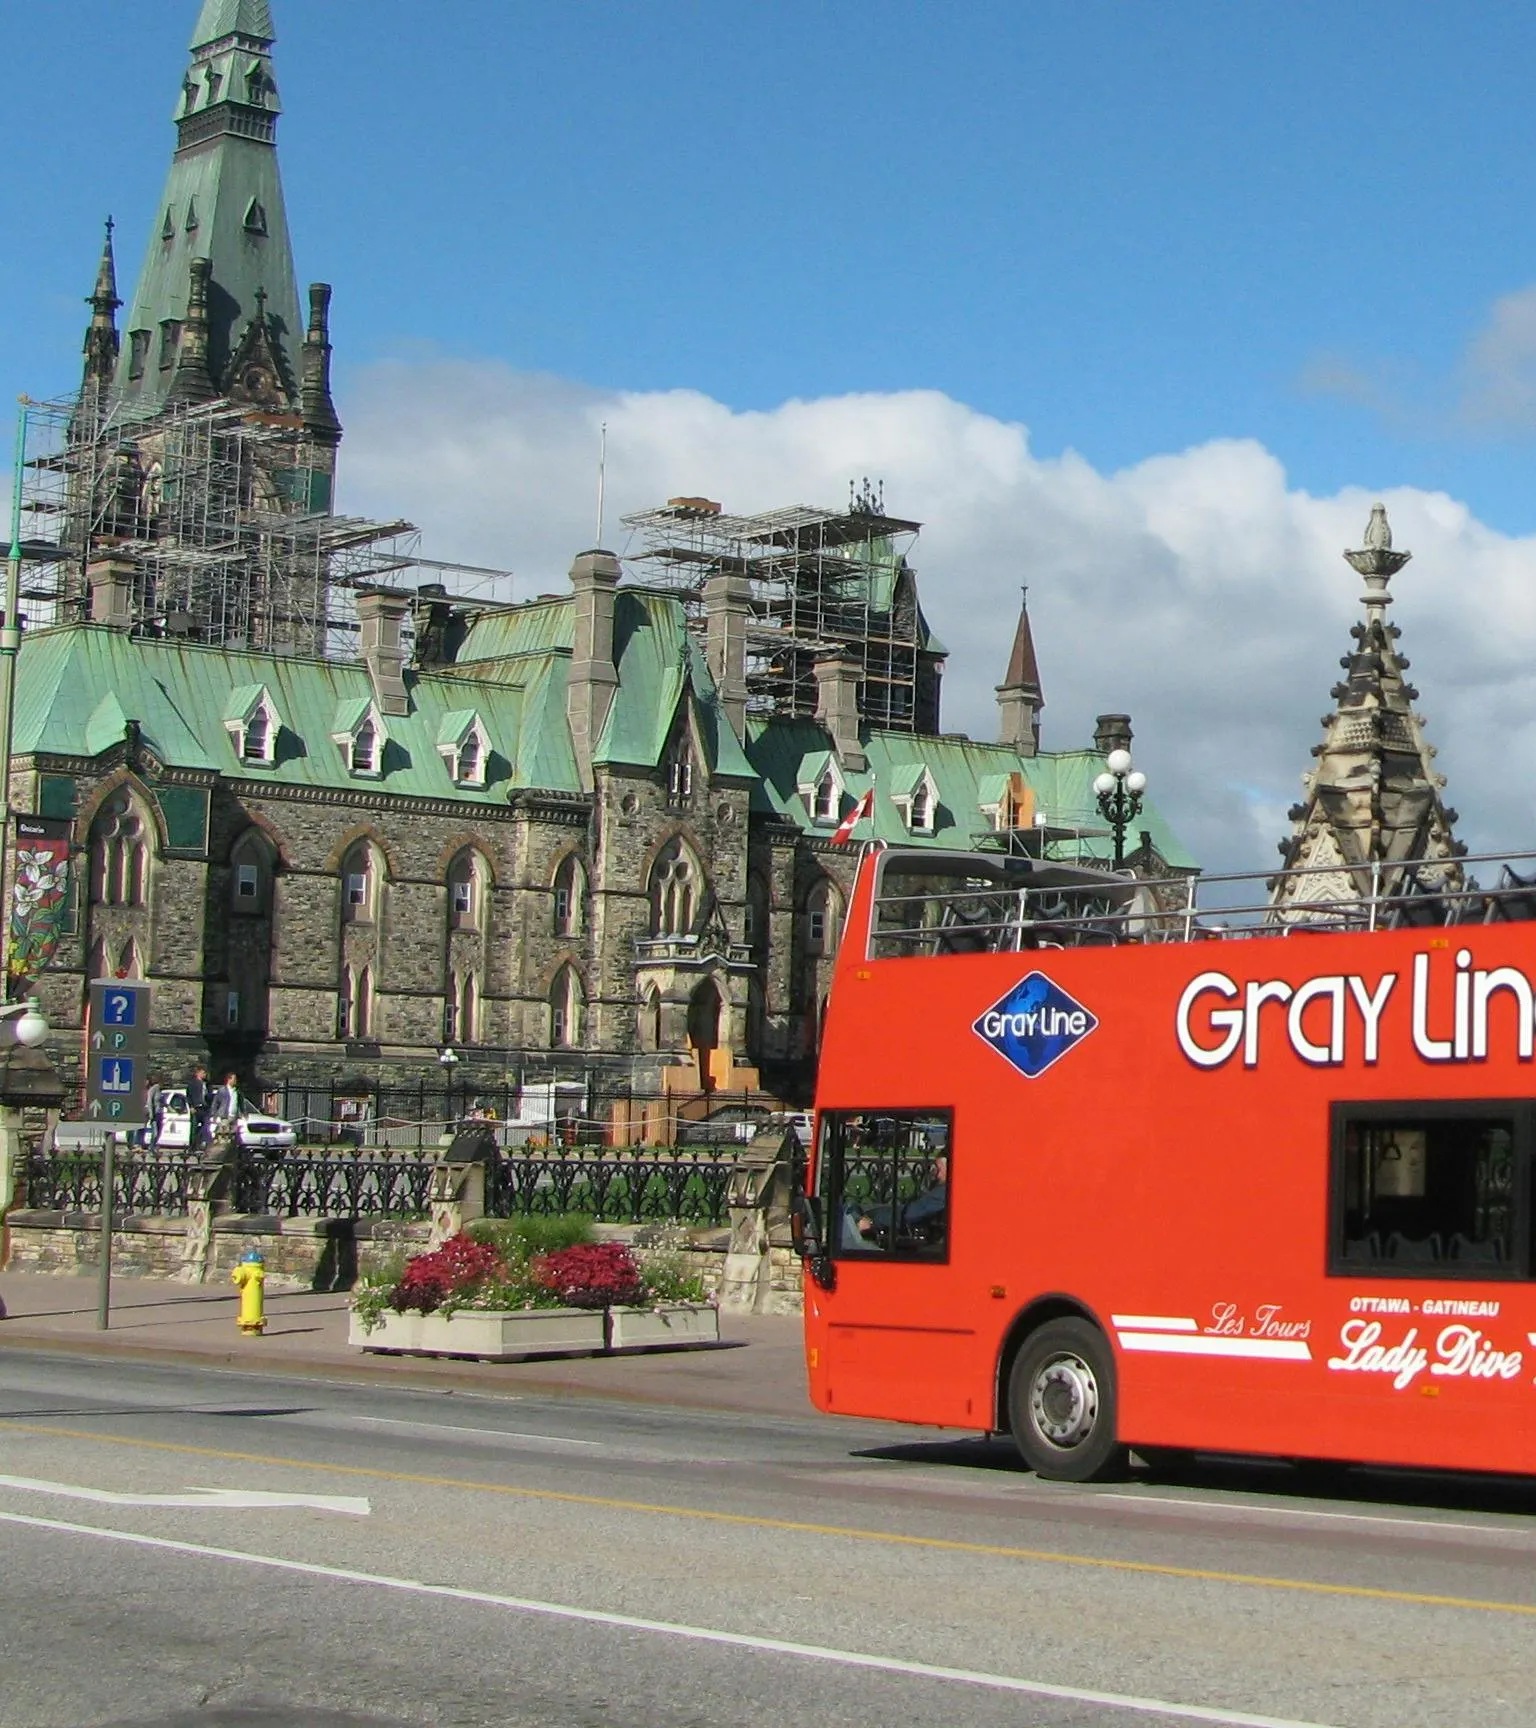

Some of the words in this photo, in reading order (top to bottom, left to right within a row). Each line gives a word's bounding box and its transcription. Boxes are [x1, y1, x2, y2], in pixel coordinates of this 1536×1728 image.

[983, 1011, 1038, 1038] Gray
[1040, 1007, 1087, 1036] Line
[1176, 971, 1398, 1070] Gray
[114, 1033, 125, 1048] P
[111, 1101, 121, 1116] P
[1204, 1302, 1245, 1335] Les
[1249, 1304, 1312, 1338] Tours
[1350, 1296, 1410, 1314] OTTAWA
[1422, 1299, 1499, 1317] GATINEAU
[1328, 1319, 1428, 1390] Lady
[1430, 1324, 1523, 1379] Dive
